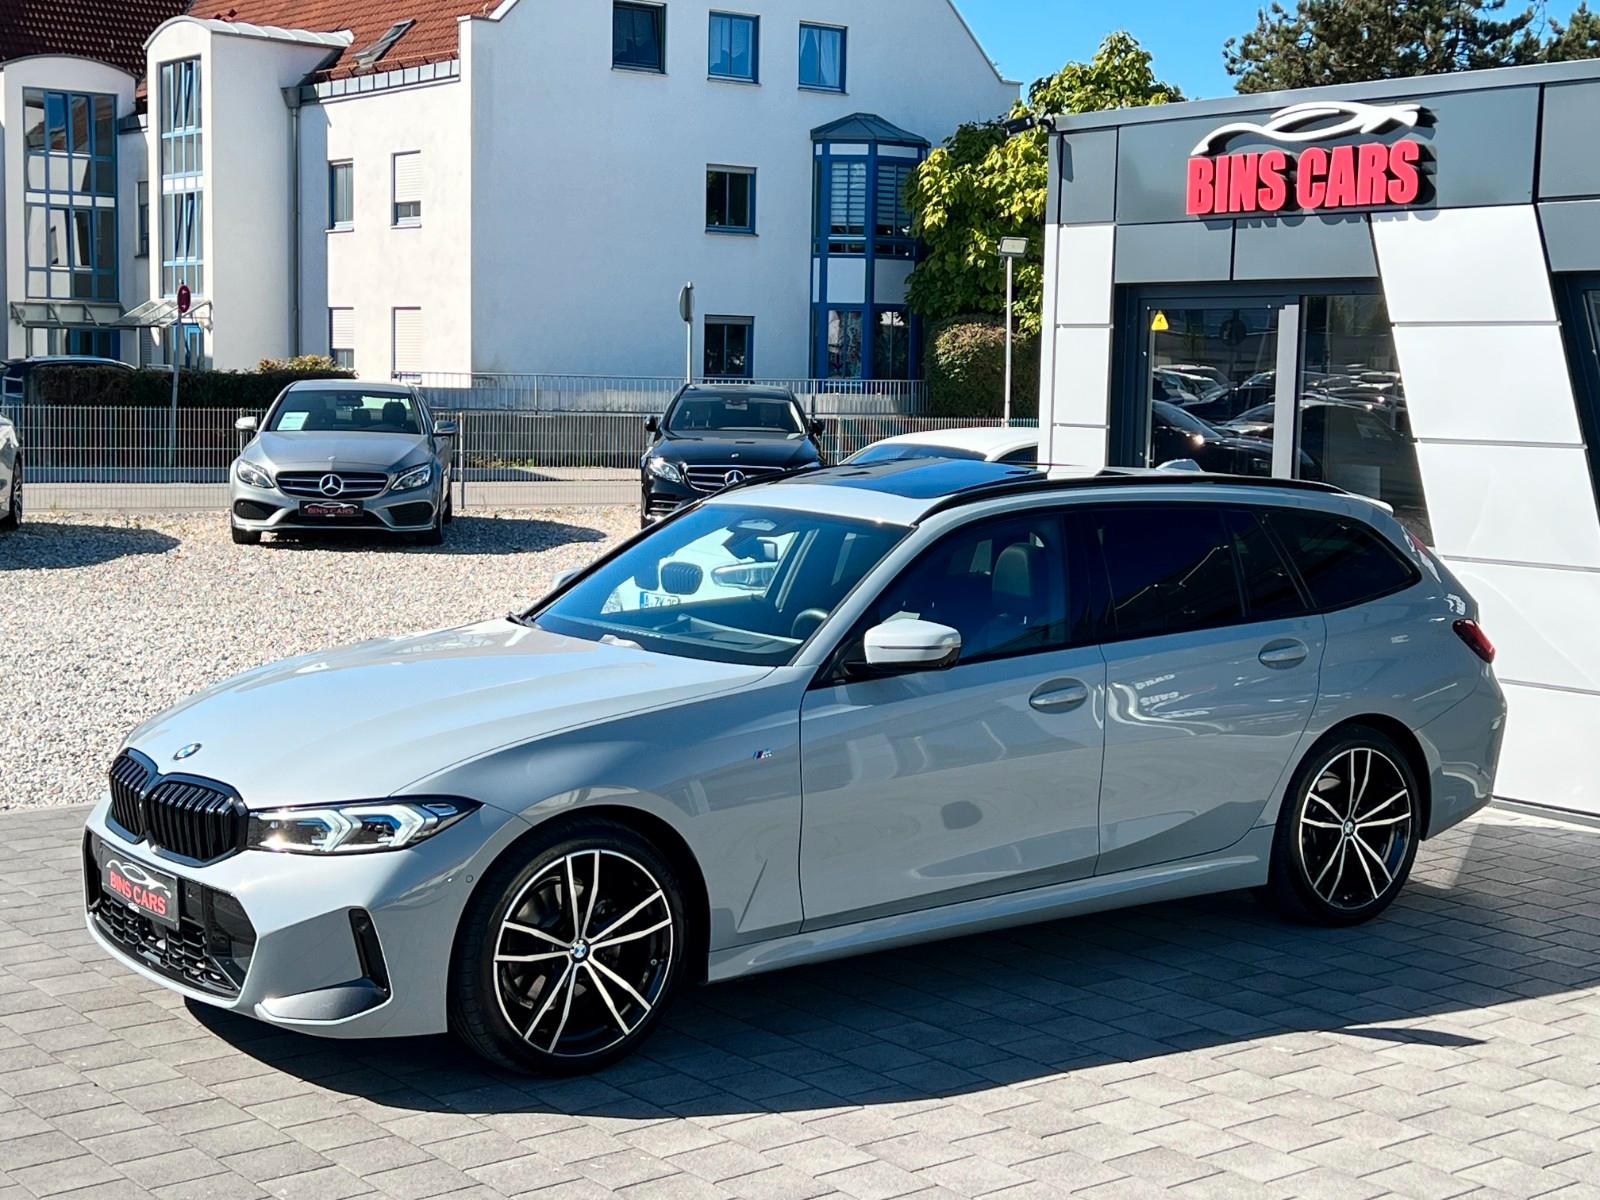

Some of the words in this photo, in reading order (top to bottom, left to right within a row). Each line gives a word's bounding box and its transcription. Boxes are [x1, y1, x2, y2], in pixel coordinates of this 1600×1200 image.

[1186, 150, 1286, 215] BINS
[1296, 140, 1419, 209] CARS
[110, 870, 132, 898] BINS
[133, 884, 166, 915] CARS
